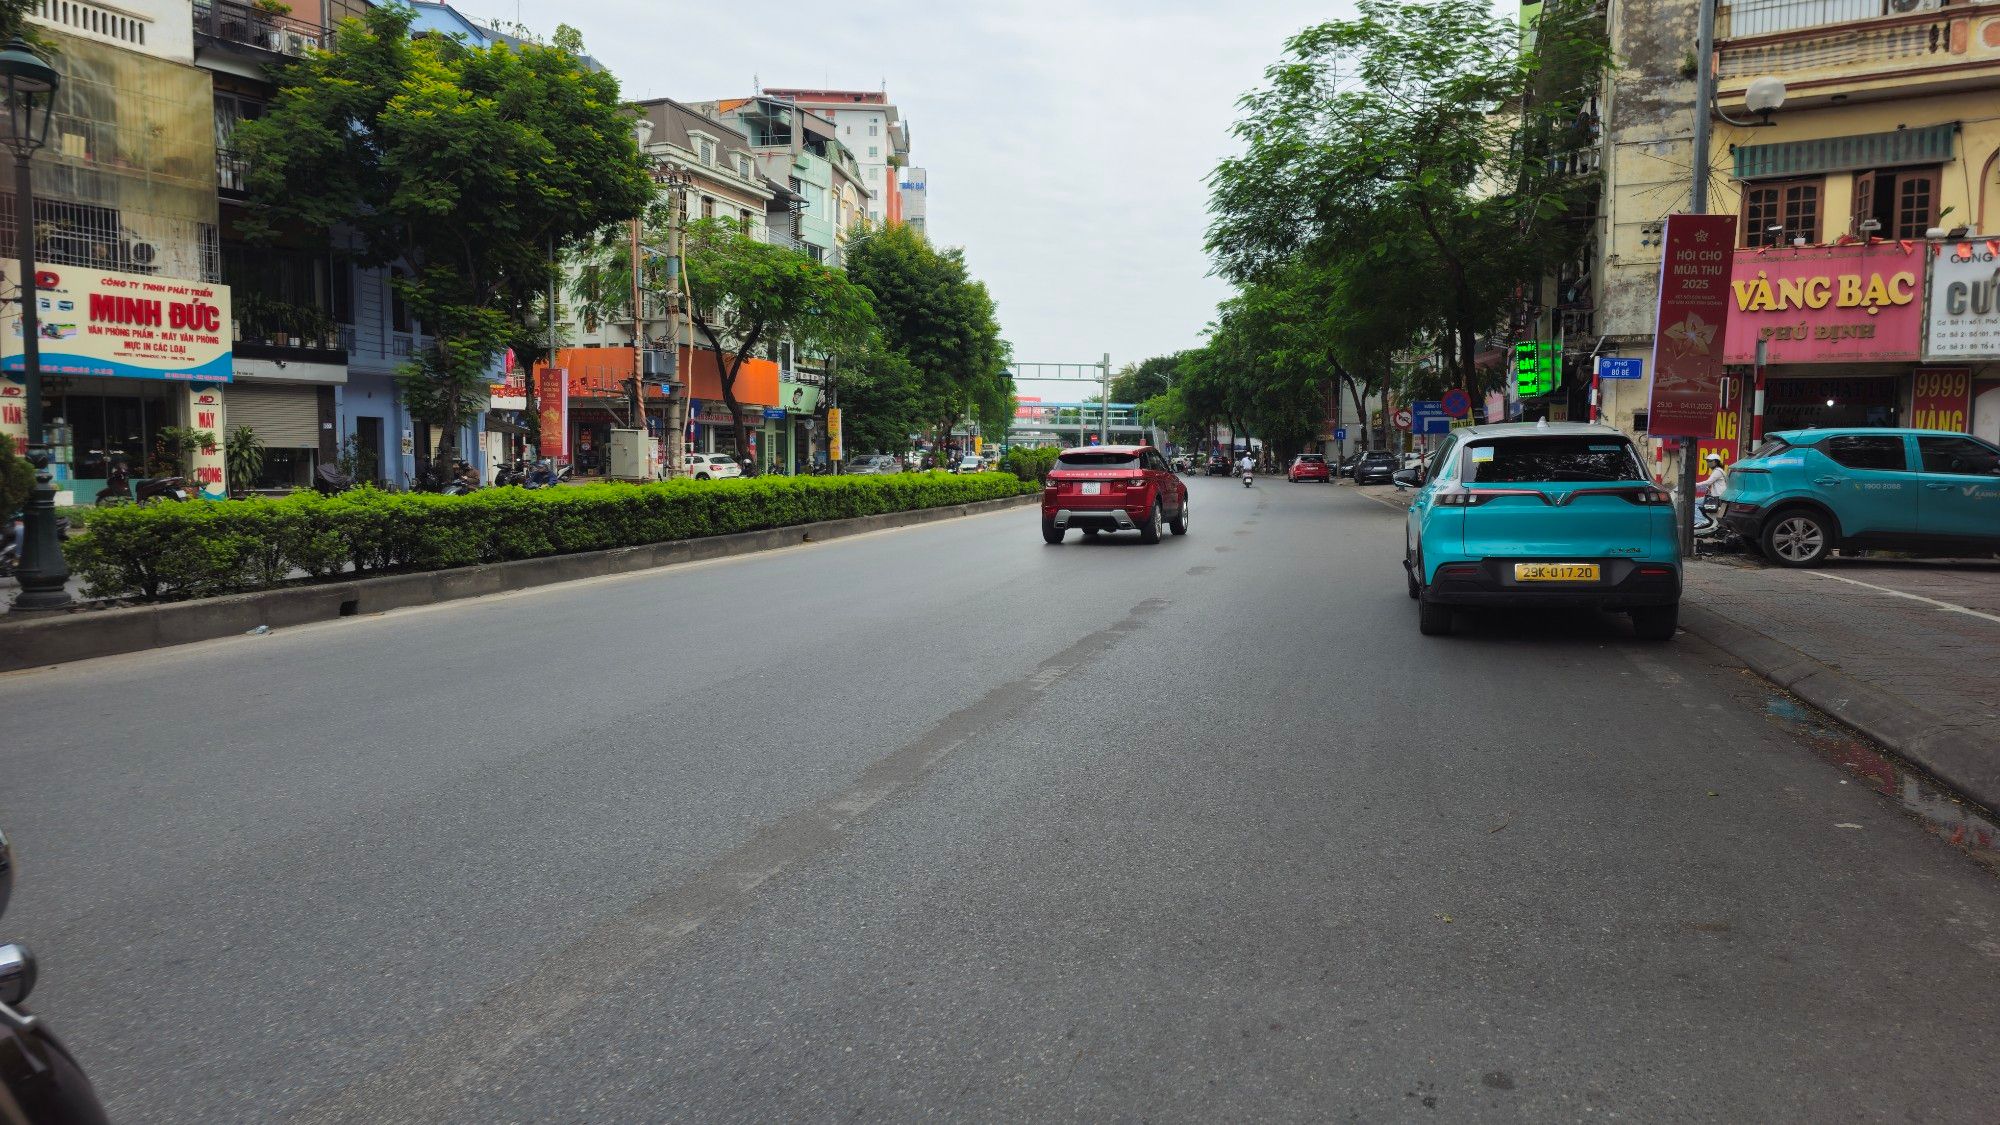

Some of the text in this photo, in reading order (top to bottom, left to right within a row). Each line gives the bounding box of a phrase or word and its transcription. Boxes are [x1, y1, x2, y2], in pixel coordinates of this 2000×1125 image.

[1701, 265, 1722, 275] THU
[101, 277, 214, 298] CÔNG TY TNHH PHÁT TRIỂN
[1682, 280, 1709, 289] 2025
[1731, 270, 1916, 315] VÀNG BẠC
[89, 293, 220, 332] MINH ĐỨC
[88, 325, 103, 335] VĂN
[105, 327, 130, 337] PHÒNG
[133, 327, 154, 339] PHẨM
[161, 331, 177, 341] MÁY
[180, 332, 194, 342] VĂN
[196, 335, 220, 345] PHÒNG
[1760, 320, 1876, 343] PHÚ ĐỊNH
[124, 341, 187, 355] MỰC IN CÁC LOẠI
[1917, 374, 1967, 398] 9999
[3, 403, 22, 424] VĂN
[198, 409, 215, 428] MÁY
[1915, 403, 1963, 432] VÀNG
[1715, 411, 1737, 440] NG
[1698, 448, 1729, 476] BC
[197, 464, 222, 482] PHÒNG
[1523, 567, 1593, 578] 29K-017.20
